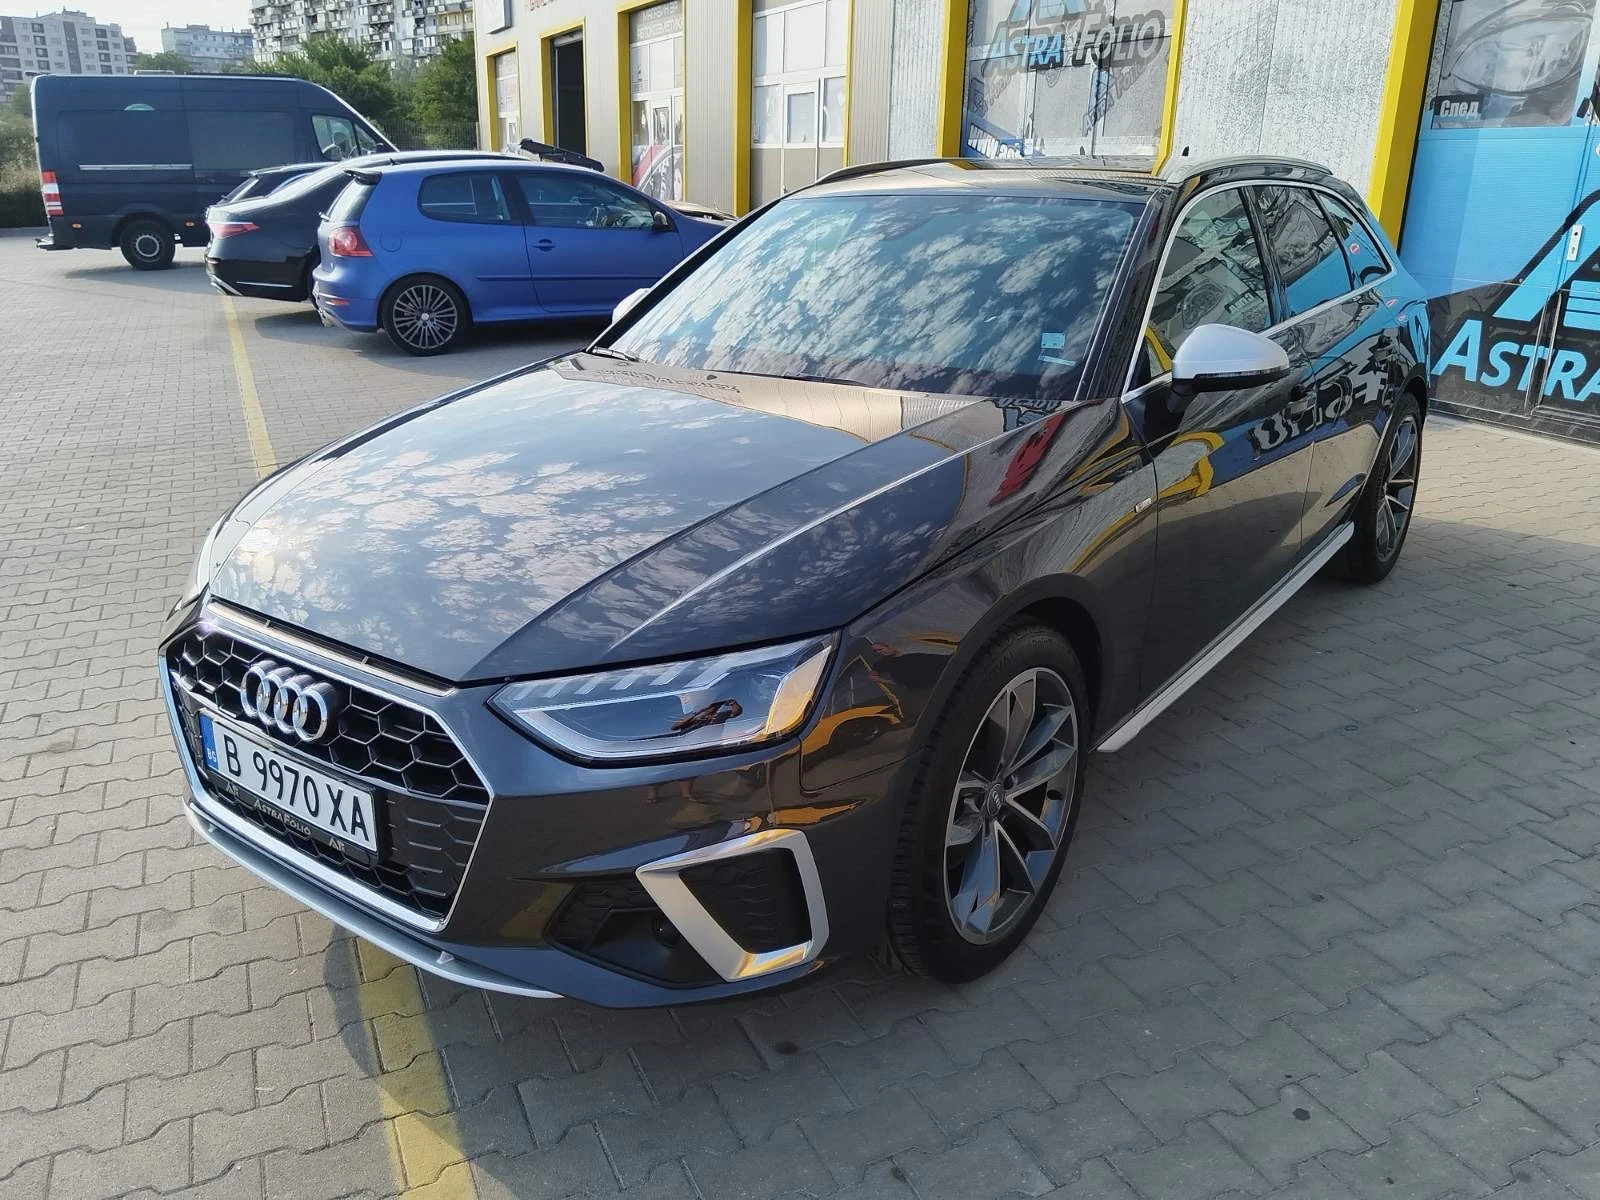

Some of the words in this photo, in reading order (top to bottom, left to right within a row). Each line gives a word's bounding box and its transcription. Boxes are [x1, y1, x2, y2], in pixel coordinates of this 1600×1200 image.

[224, 734, 241, 777] B
[252, 751, 319, 818] 9970
[326, 783, 369, 842] XA
